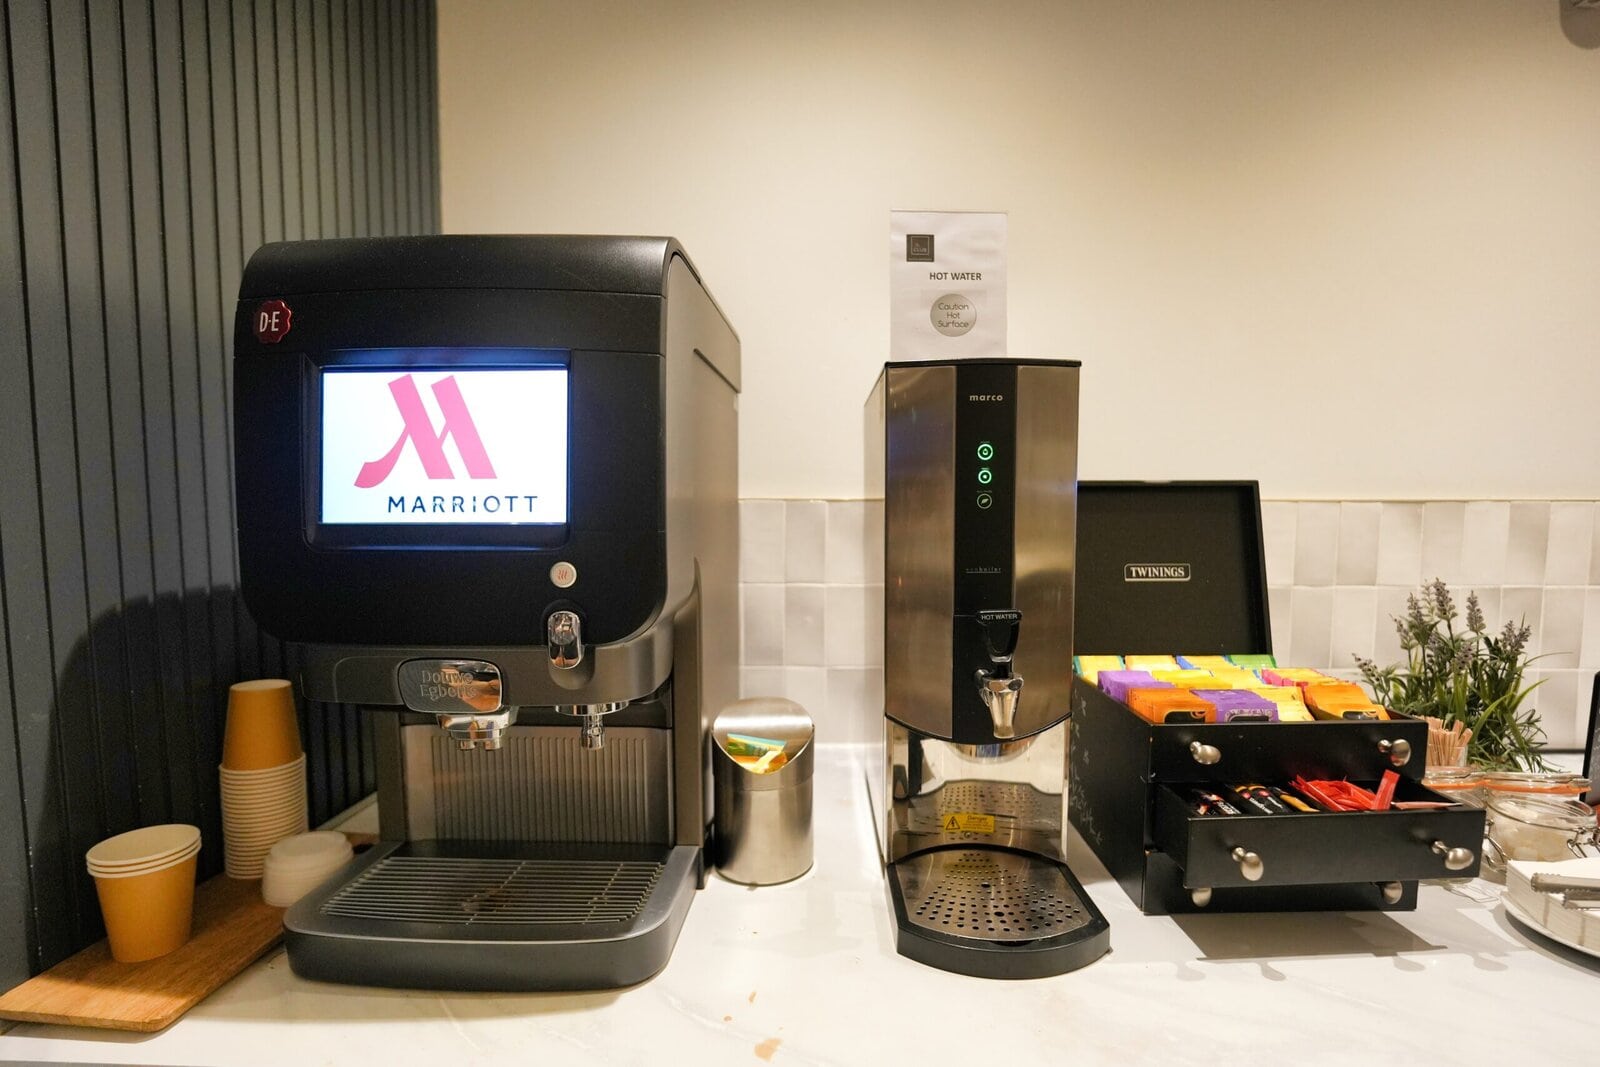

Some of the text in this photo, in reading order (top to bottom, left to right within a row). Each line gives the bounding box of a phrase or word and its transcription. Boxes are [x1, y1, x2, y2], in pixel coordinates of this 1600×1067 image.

[929, 272, 982, 281] HOT WATER
[938, 302, 969, 310] Caution
[946, 312, 961, 320] Hot
[387, 495, 538, 513] MARRIOTT
[1129, 566, 1186, 578] TWININGS
[421, 670, 474, 685] Douwe
